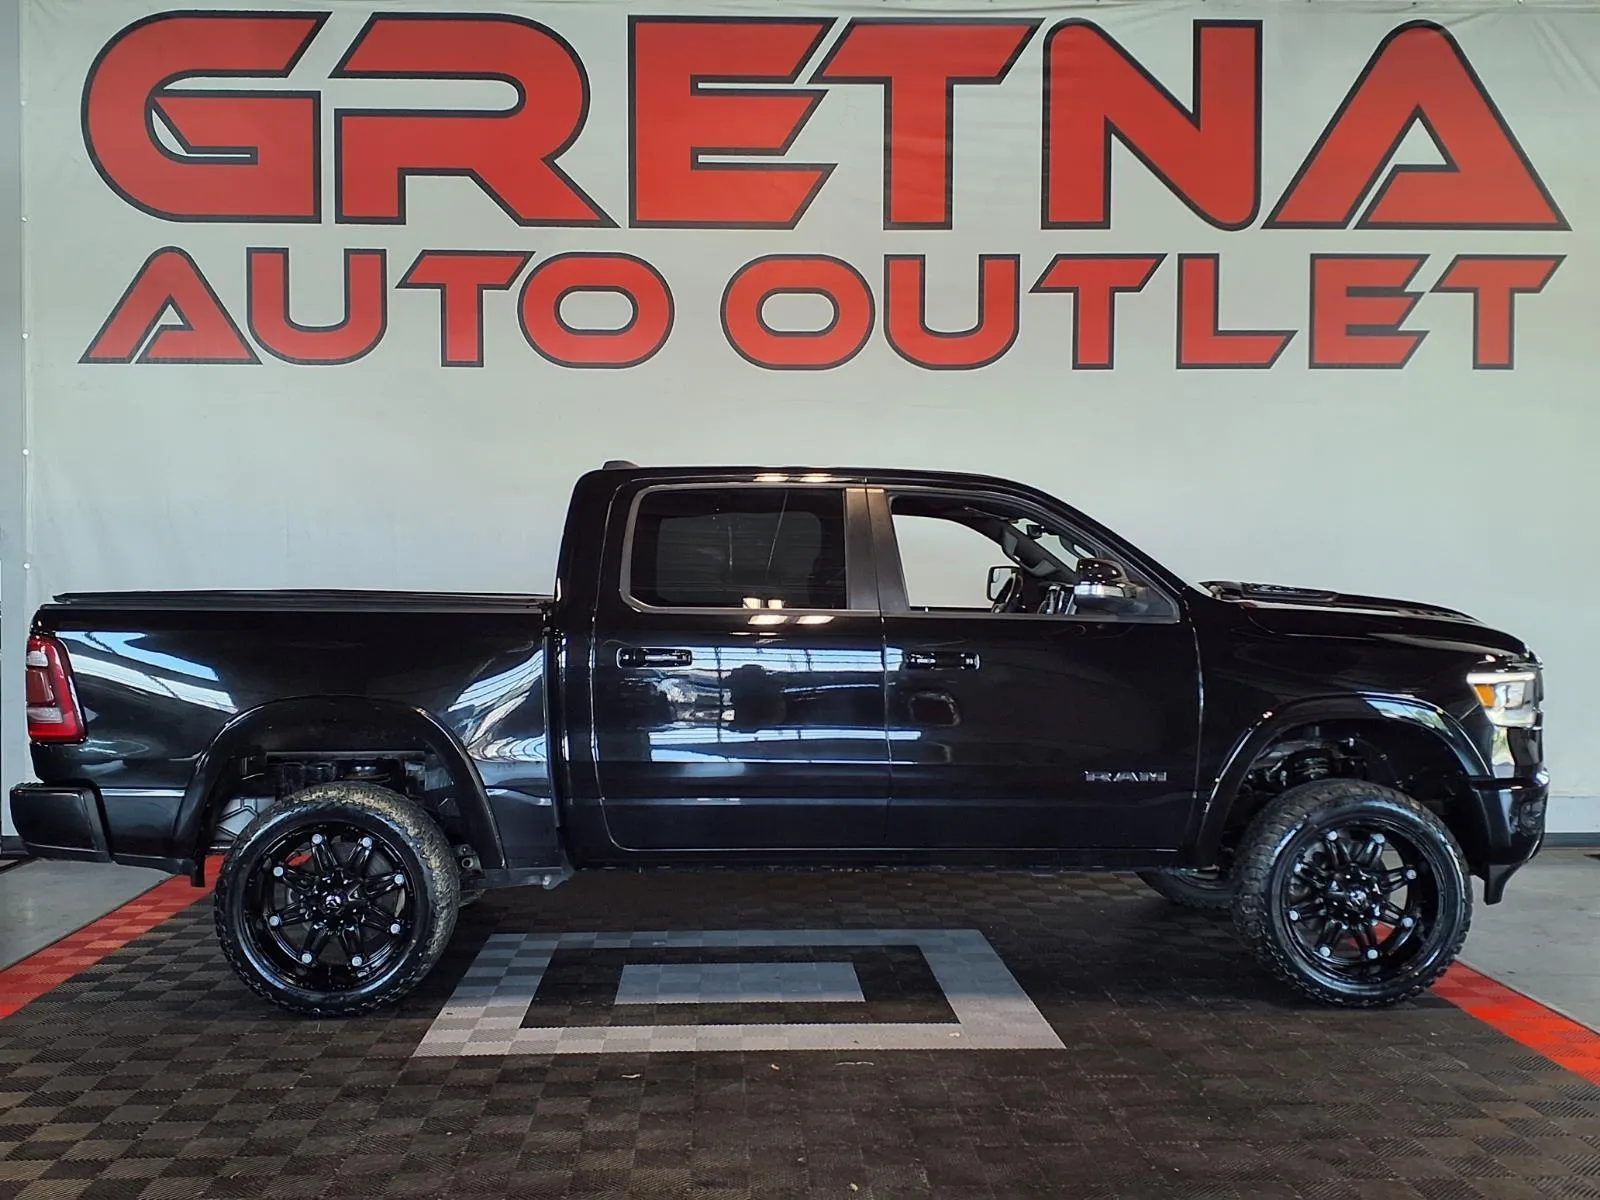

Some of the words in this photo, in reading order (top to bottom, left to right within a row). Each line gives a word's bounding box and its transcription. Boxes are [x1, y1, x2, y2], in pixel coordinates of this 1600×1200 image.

[81, 10, 1572, 231] GRETNA
[78, 246, 675, 369] AUTO
[720, 253, 1567, 370] OUTLET
[1084, 770, 1167, 782] RAM
